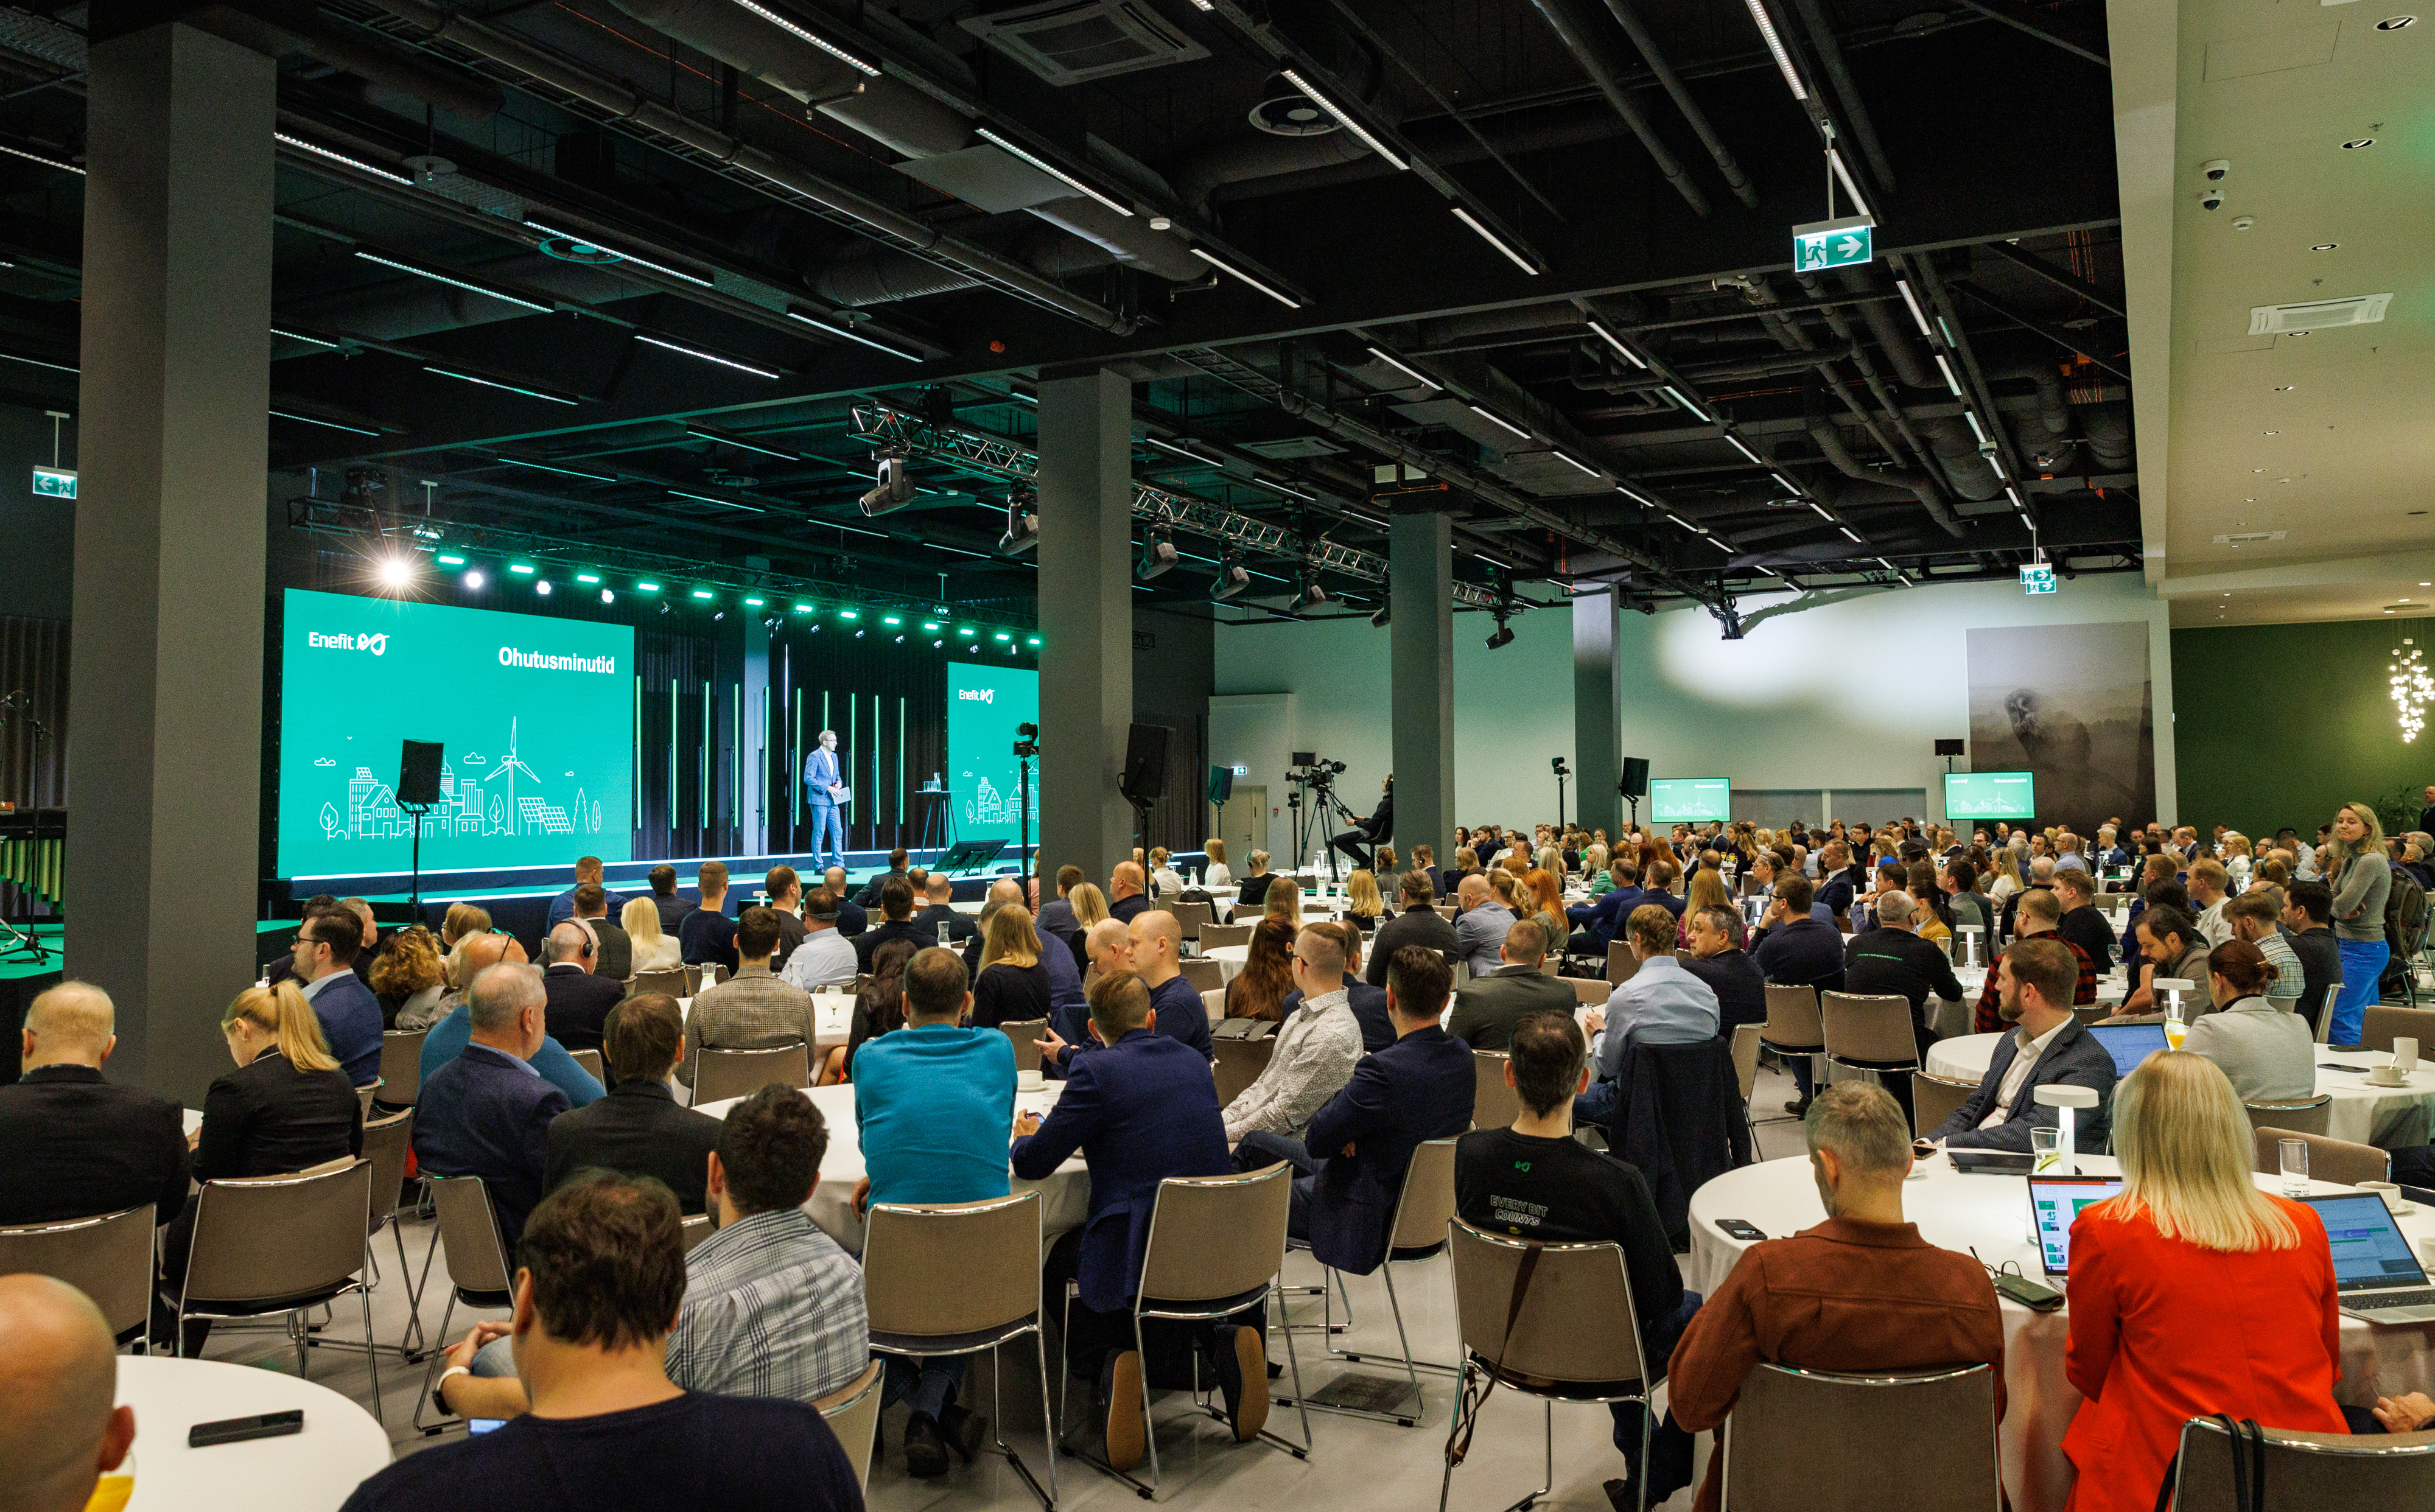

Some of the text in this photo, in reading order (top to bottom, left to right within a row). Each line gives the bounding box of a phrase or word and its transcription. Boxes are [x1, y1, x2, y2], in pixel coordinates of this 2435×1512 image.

[309, 631, 354, 650] Enefit
[499, 646, 615, 674] Ohutusminutid
[959, 689, 979, 701] Enefit
[1490, 1195, 1548, 1217] EVERY BIT
[1495, 1208, 1541, 1226] COUNTS
